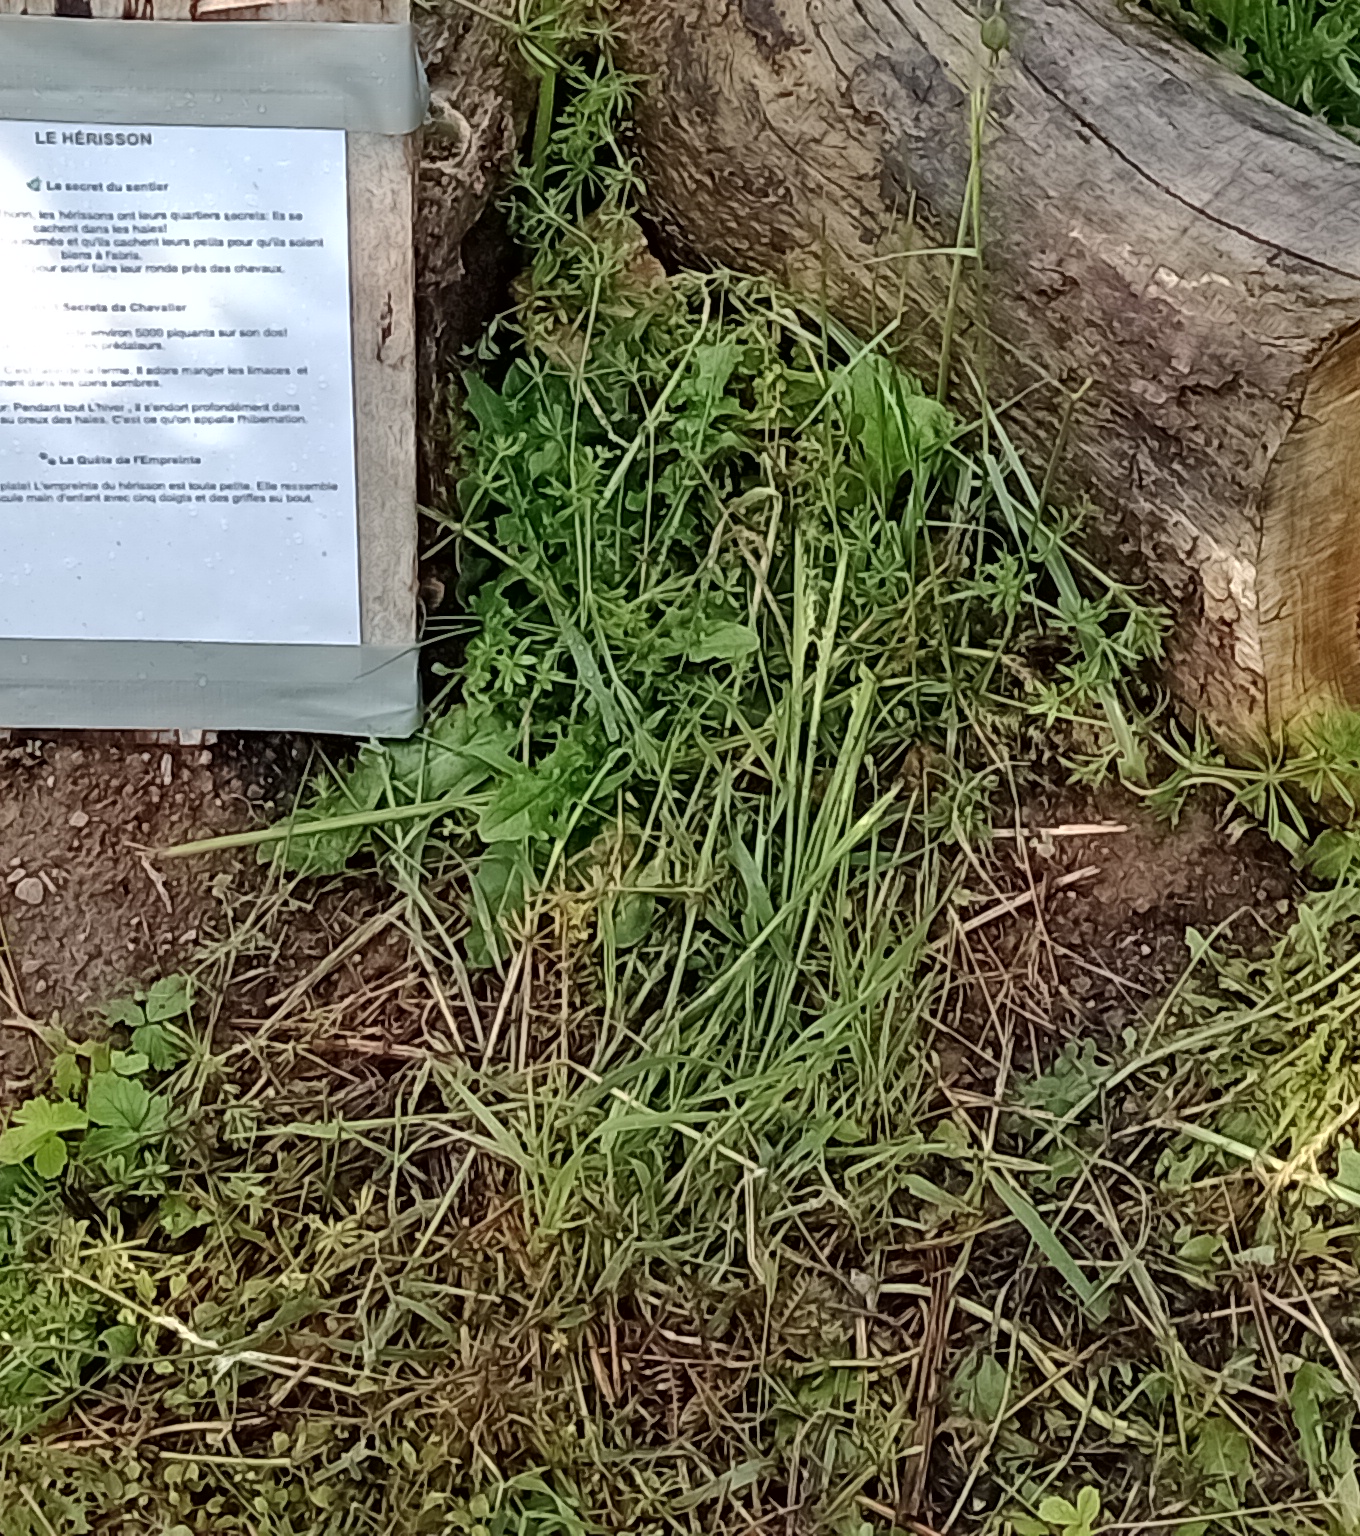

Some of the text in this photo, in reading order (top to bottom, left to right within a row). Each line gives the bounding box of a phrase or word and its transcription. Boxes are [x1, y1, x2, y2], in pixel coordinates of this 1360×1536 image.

[35, 129, 153, 146] LE HÉRISSON
[46, 181, 168, 192] Le secret du sentier
[58, 210, 115, 221] hérissons
[170, 211, 220, 222] quartiers
[289, 213, 303, 221] se
[33, 224, 78, 234] cachent
[81, 224, 109, 234] dans
[112, 224, 129, 234] les
[67, 237, 78, 246] et
[114, 237, 159, 247] cachent
[228, 239, 253, 249] pour
[95, 250, 103, 260] à
[145, 264, 178, 274] ronde
[182, 264, 207, 275] près
[210, 264, 231, 274] des
[111, 303, 127, 312] de
[129, 303, 187, 312] Chevalier
[167, 328, 215, 340] piquants
[218, 329, 237, 338] sur
[239, 329, 260, 338] son
[146, 366, 178, 375] adore
[182, 367, 225, 377] manger
[228, 366, 244, 375] les
[297, 366, 308, 375] et
[13, 403, 60, 412] Pendant
[192, 402, 269, 413] profondément
[272, 403, 300, 412] dans
[0, 416, 14, 424] au
[17, 416, 48, 424] creux
[51, 415, 72, 424] des
[143, 416, 157, 424] ce
[59, 456, 74, 465] La
[115, 456, 130, 465] de
[102, 482, 116, 491] du
[119, 482, 165, 491] hérisson
[169, 482, 186, 491] est
[189, 482, 217, 491] toute
[280, 482, 338, 491] ressemble
[26, 494, 54, 503] main
[104, 494, 130, 503] avec
[133, 494, 156, 504] cinq
[159, 494, 192, 504] doigts
[195, 494, 206, 503] et
[209, 494, 229, 503] des
[269, 495, 283, 503] au
